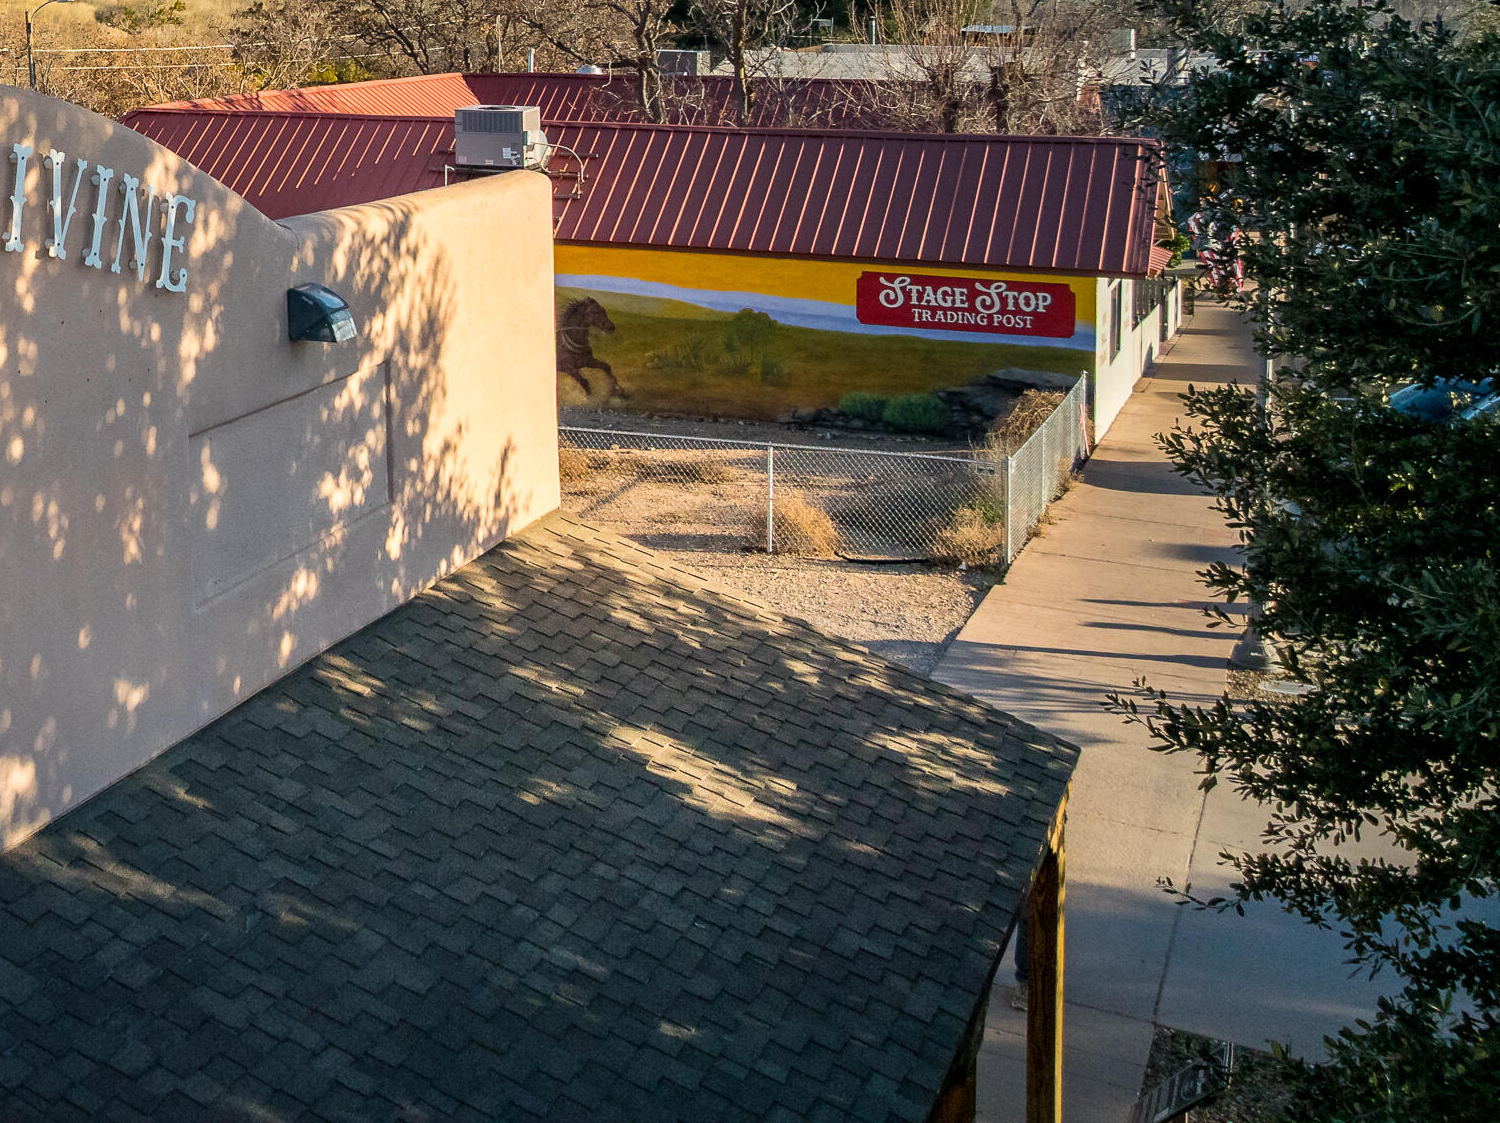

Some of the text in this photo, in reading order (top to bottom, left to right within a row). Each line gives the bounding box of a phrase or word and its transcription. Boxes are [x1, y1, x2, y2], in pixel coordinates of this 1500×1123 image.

[879, 276, 1051, 314] STAGE STOP
[912, 308, 1033, 328] TRADING POST
